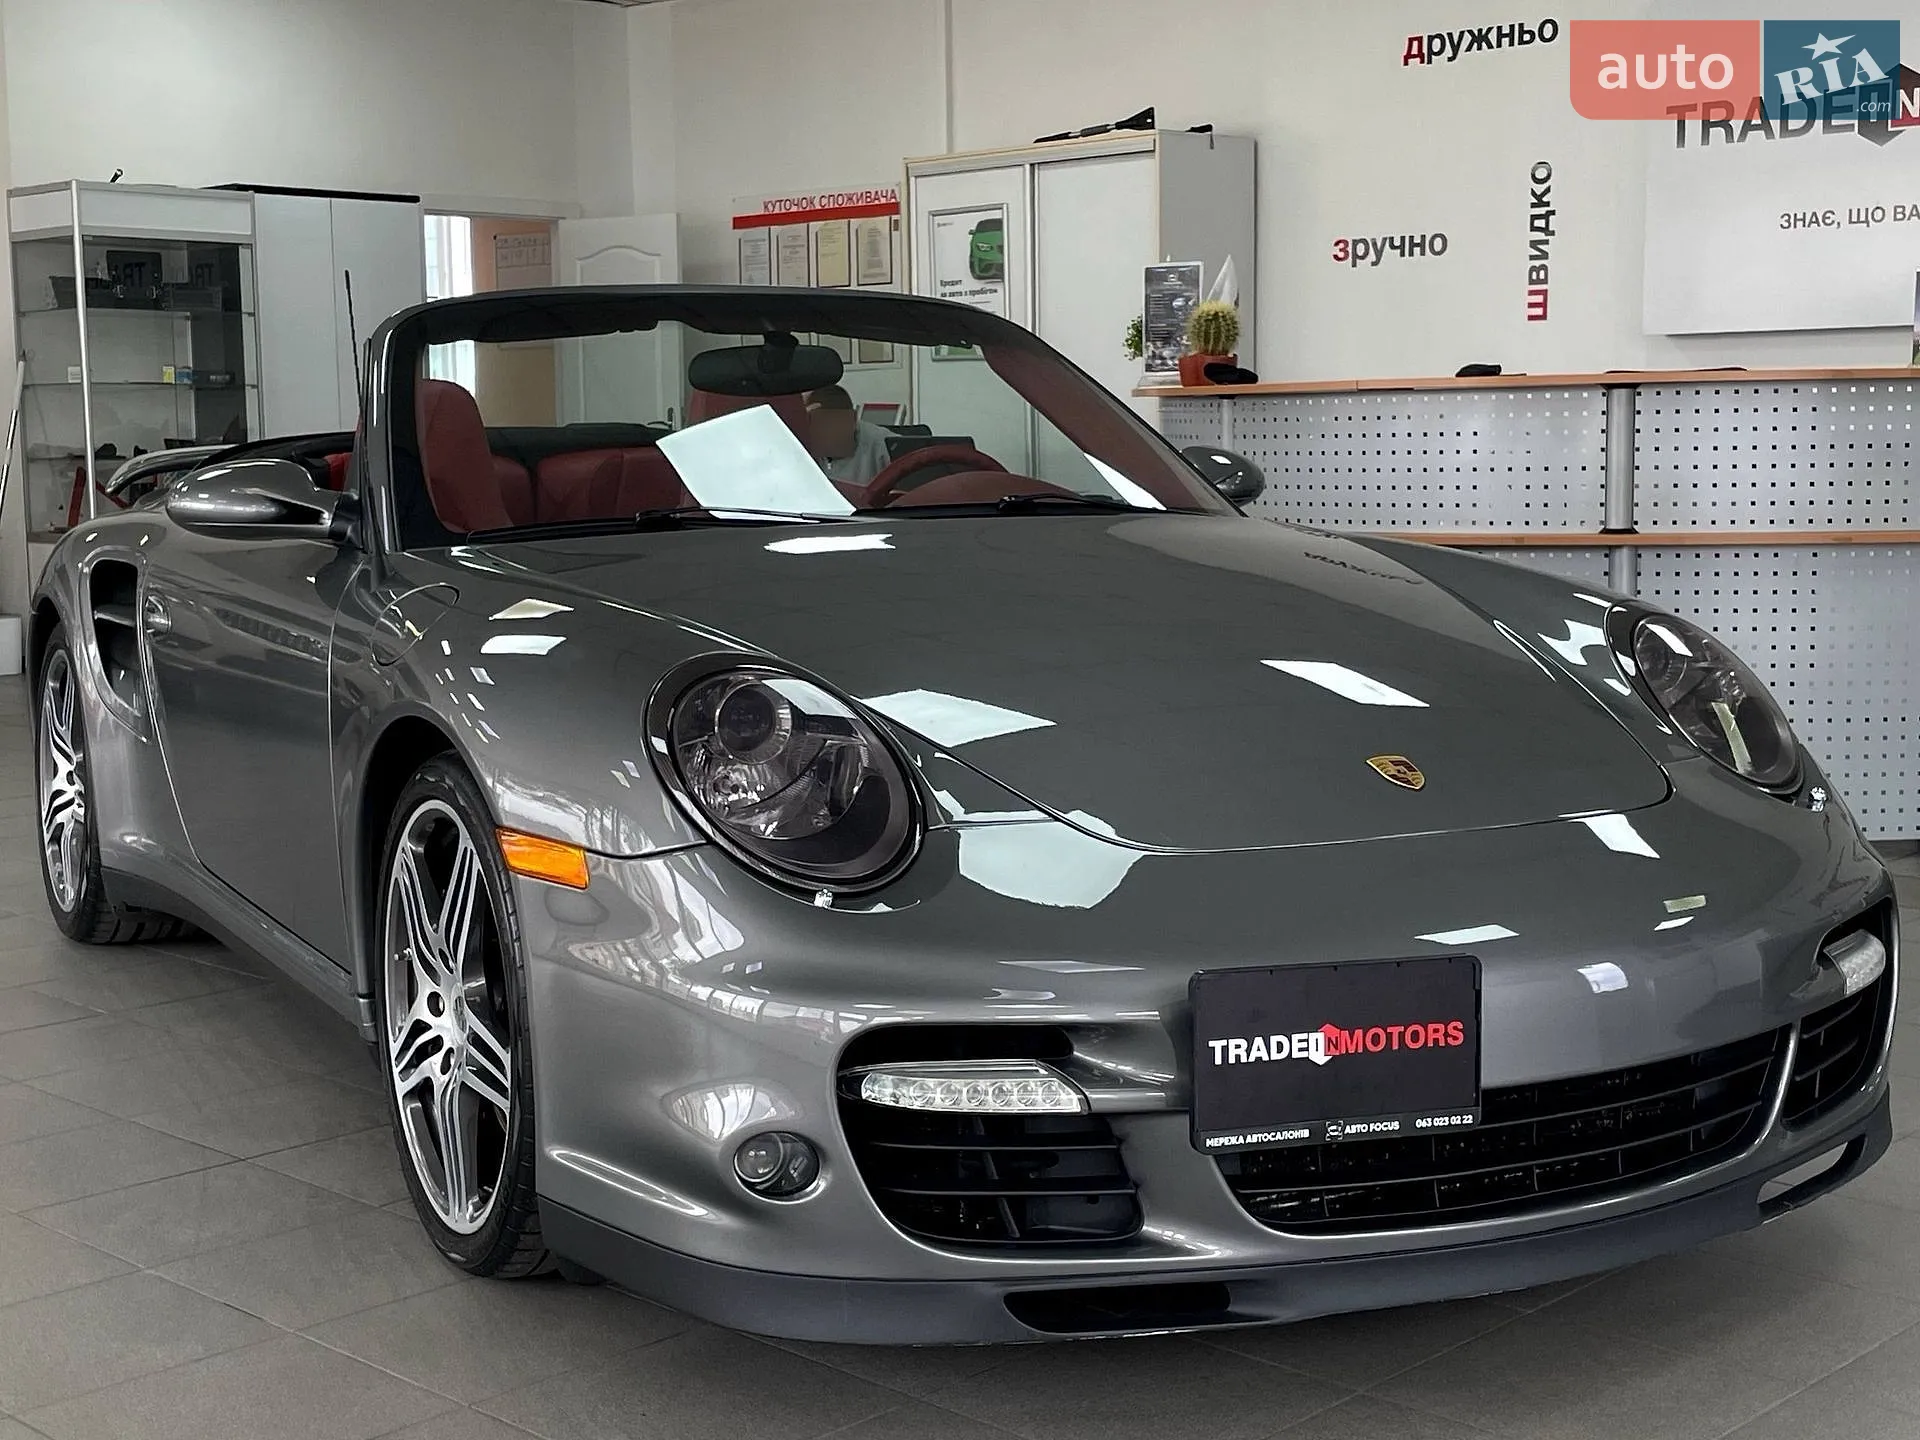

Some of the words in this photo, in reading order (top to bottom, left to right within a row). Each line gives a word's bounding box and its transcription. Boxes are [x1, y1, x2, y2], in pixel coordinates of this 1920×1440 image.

[1402, 18, 1560, 66] дружньо
[762, 195, 817, 213] КУТОЧОК
[819, 188, 898, 209] СПОЖИВАЧА
[1779, 210, 1841, 230] ЗНАЄ,
[1848, 206, 1886, 228] ЩО
[1332, 232, 1449, 268] зручно
[1527, 160, 1556, 321] швидко
[1369, 1120, 1400, 1132] FOCUS
[1415, 1118, 1432, 1129] 063
[1462, 1114, 1474, 1124] 22
[1205, 1135, 1245, 1148] МЕРЕЖА
